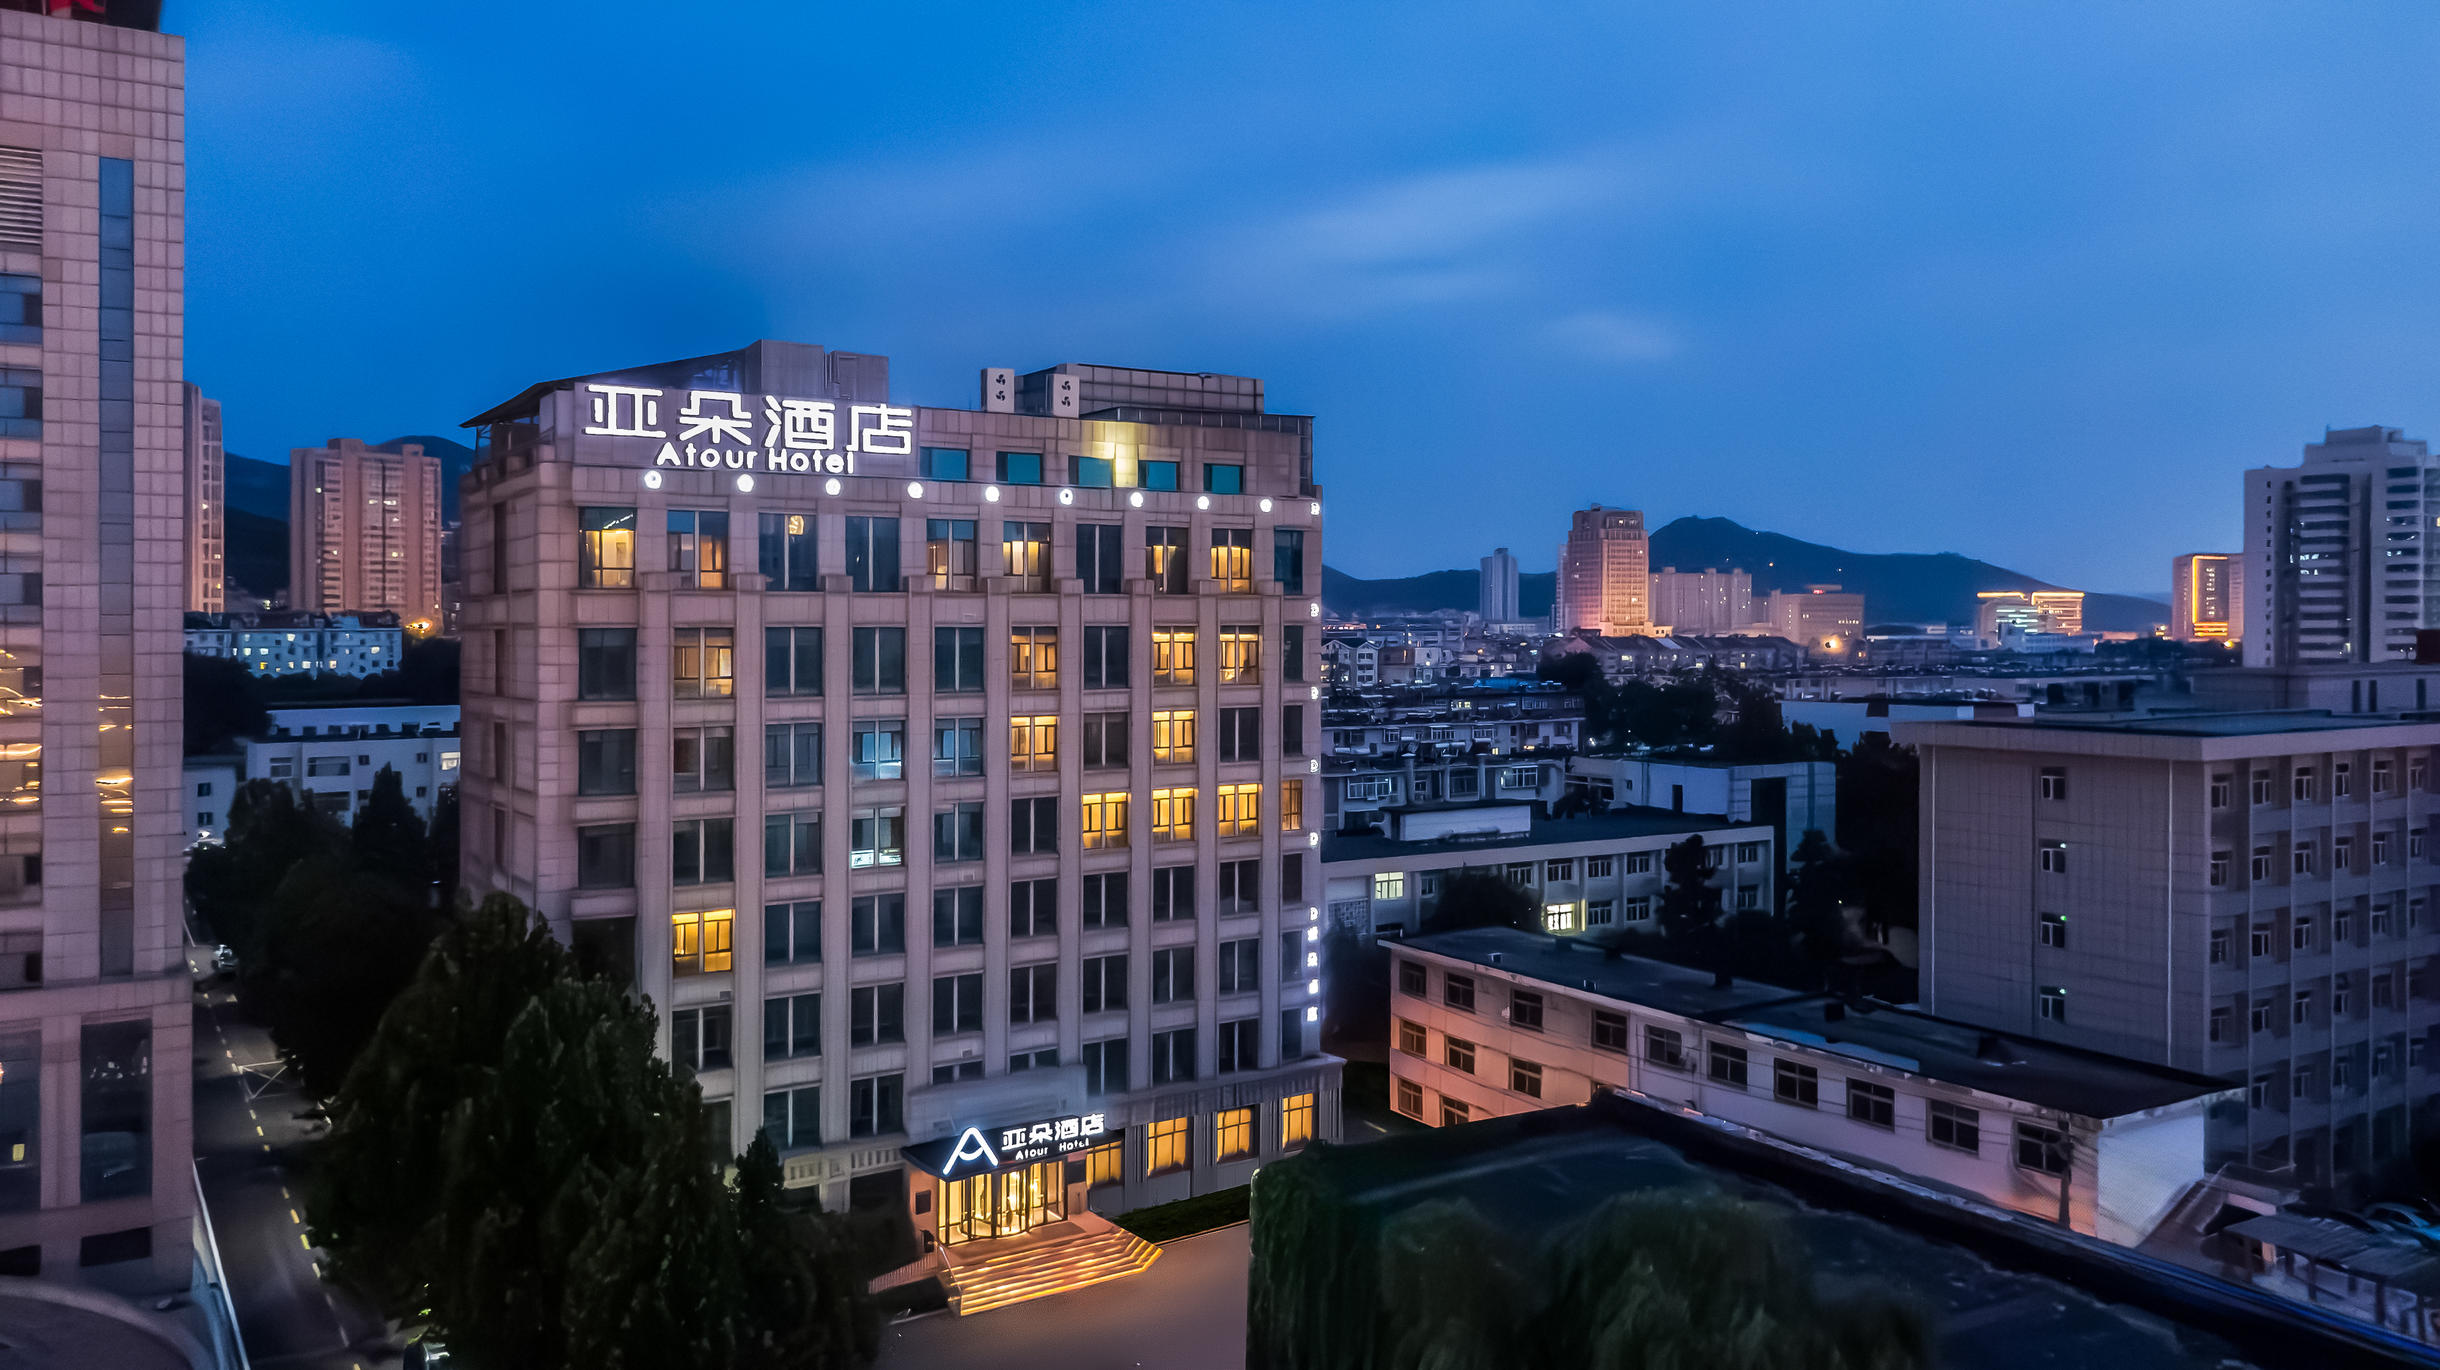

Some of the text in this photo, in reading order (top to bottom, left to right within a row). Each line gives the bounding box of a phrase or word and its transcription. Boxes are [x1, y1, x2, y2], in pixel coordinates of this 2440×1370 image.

[584, 383, 914, 455] 亚朵酒店
[656, 441, 854, 474] Atour Hotel
[1001, 1113, 1105, 1151] 亚朵酒店
[1059, 1137, 1090, 1152] Hotel
